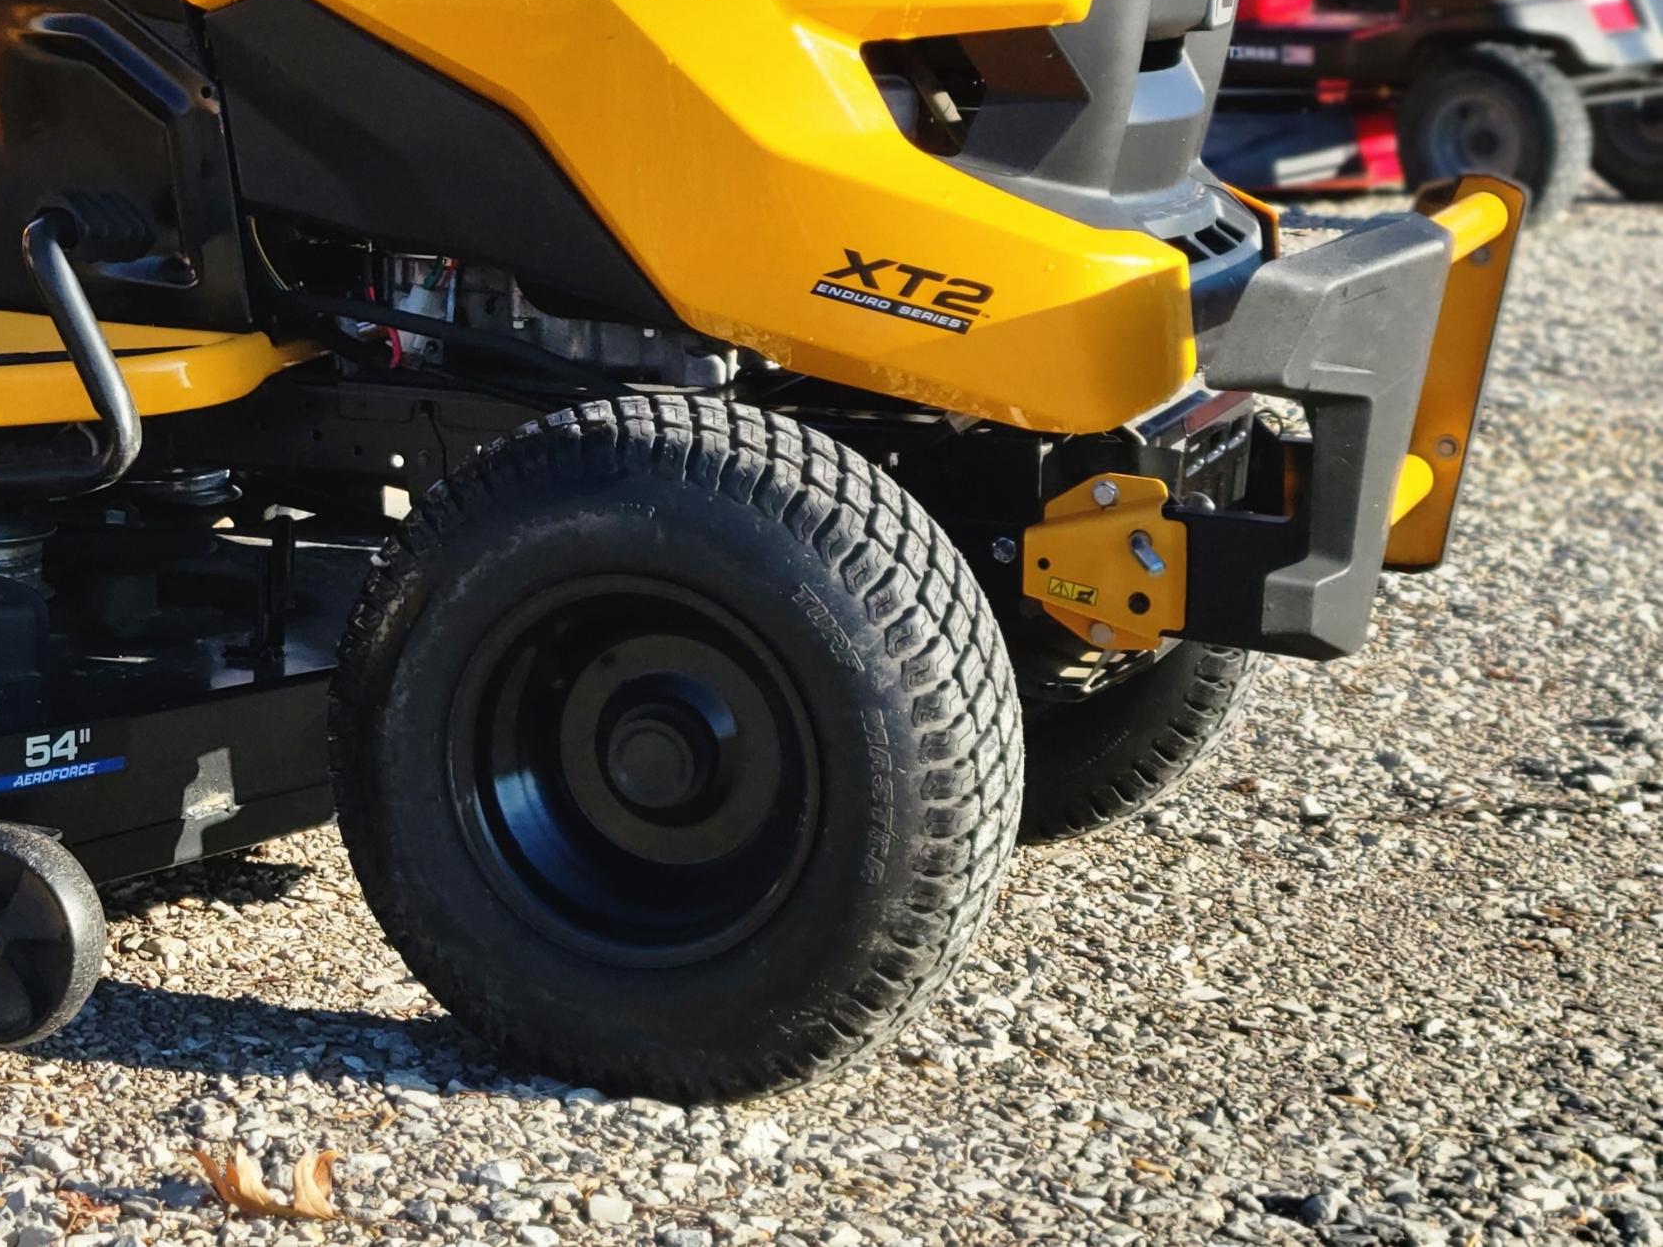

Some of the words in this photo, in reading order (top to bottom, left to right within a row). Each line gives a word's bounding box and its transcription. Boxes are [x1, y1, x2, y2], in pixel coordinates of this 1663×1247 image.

[822, 248, 994, 316] XT2
[816, 283, 892, 310] ENDURO
[898, 305, 963, 329] SERIES
[25, 728, 91, 768] 54"
[13, 761, 96, 788] AEROFORCE
